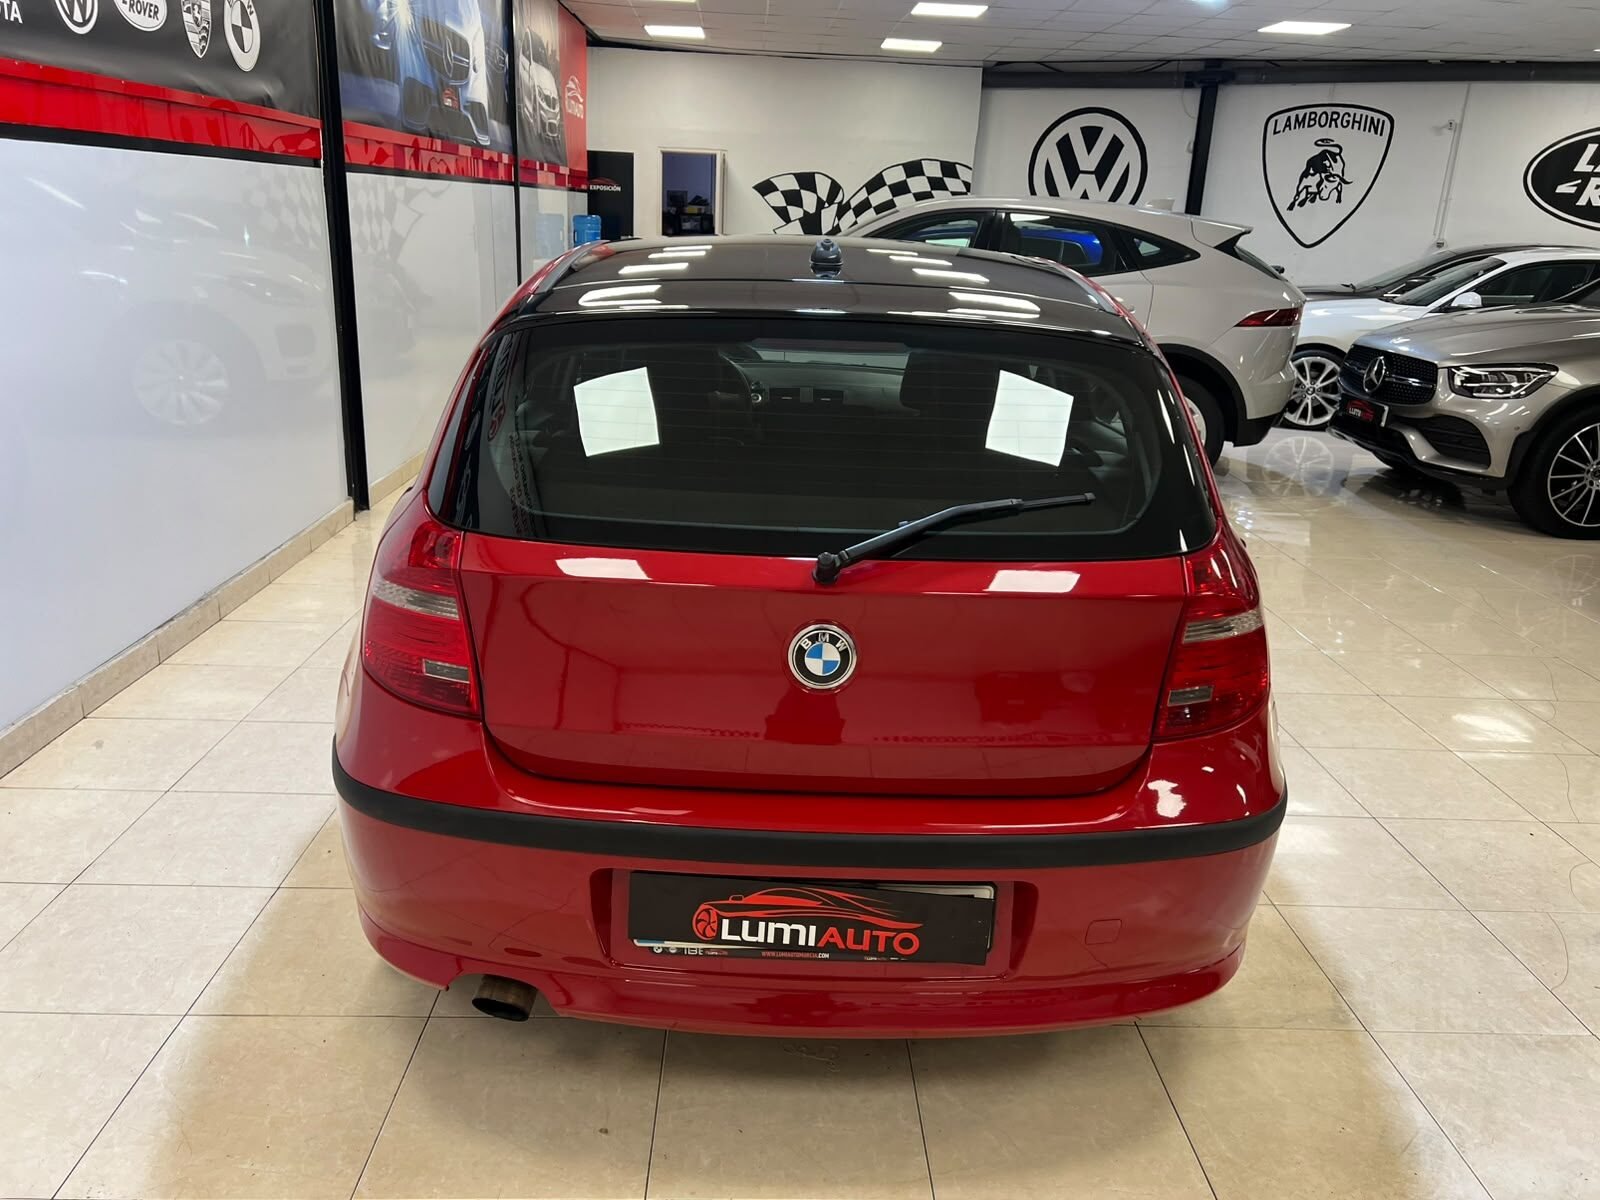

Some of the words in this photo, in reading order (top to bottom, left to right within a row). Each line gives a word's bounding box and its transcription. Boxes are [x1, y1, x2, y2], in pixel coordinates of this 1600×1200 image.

[0, 0, 23, 24] TA
[1273, 110, 1386, 137] LAMBORGHINI
[1573, 143, 1600, 172] L
[589, 184, 621, 192] EXPOSICIÓN
[800, 632, 848, 652] BMW
